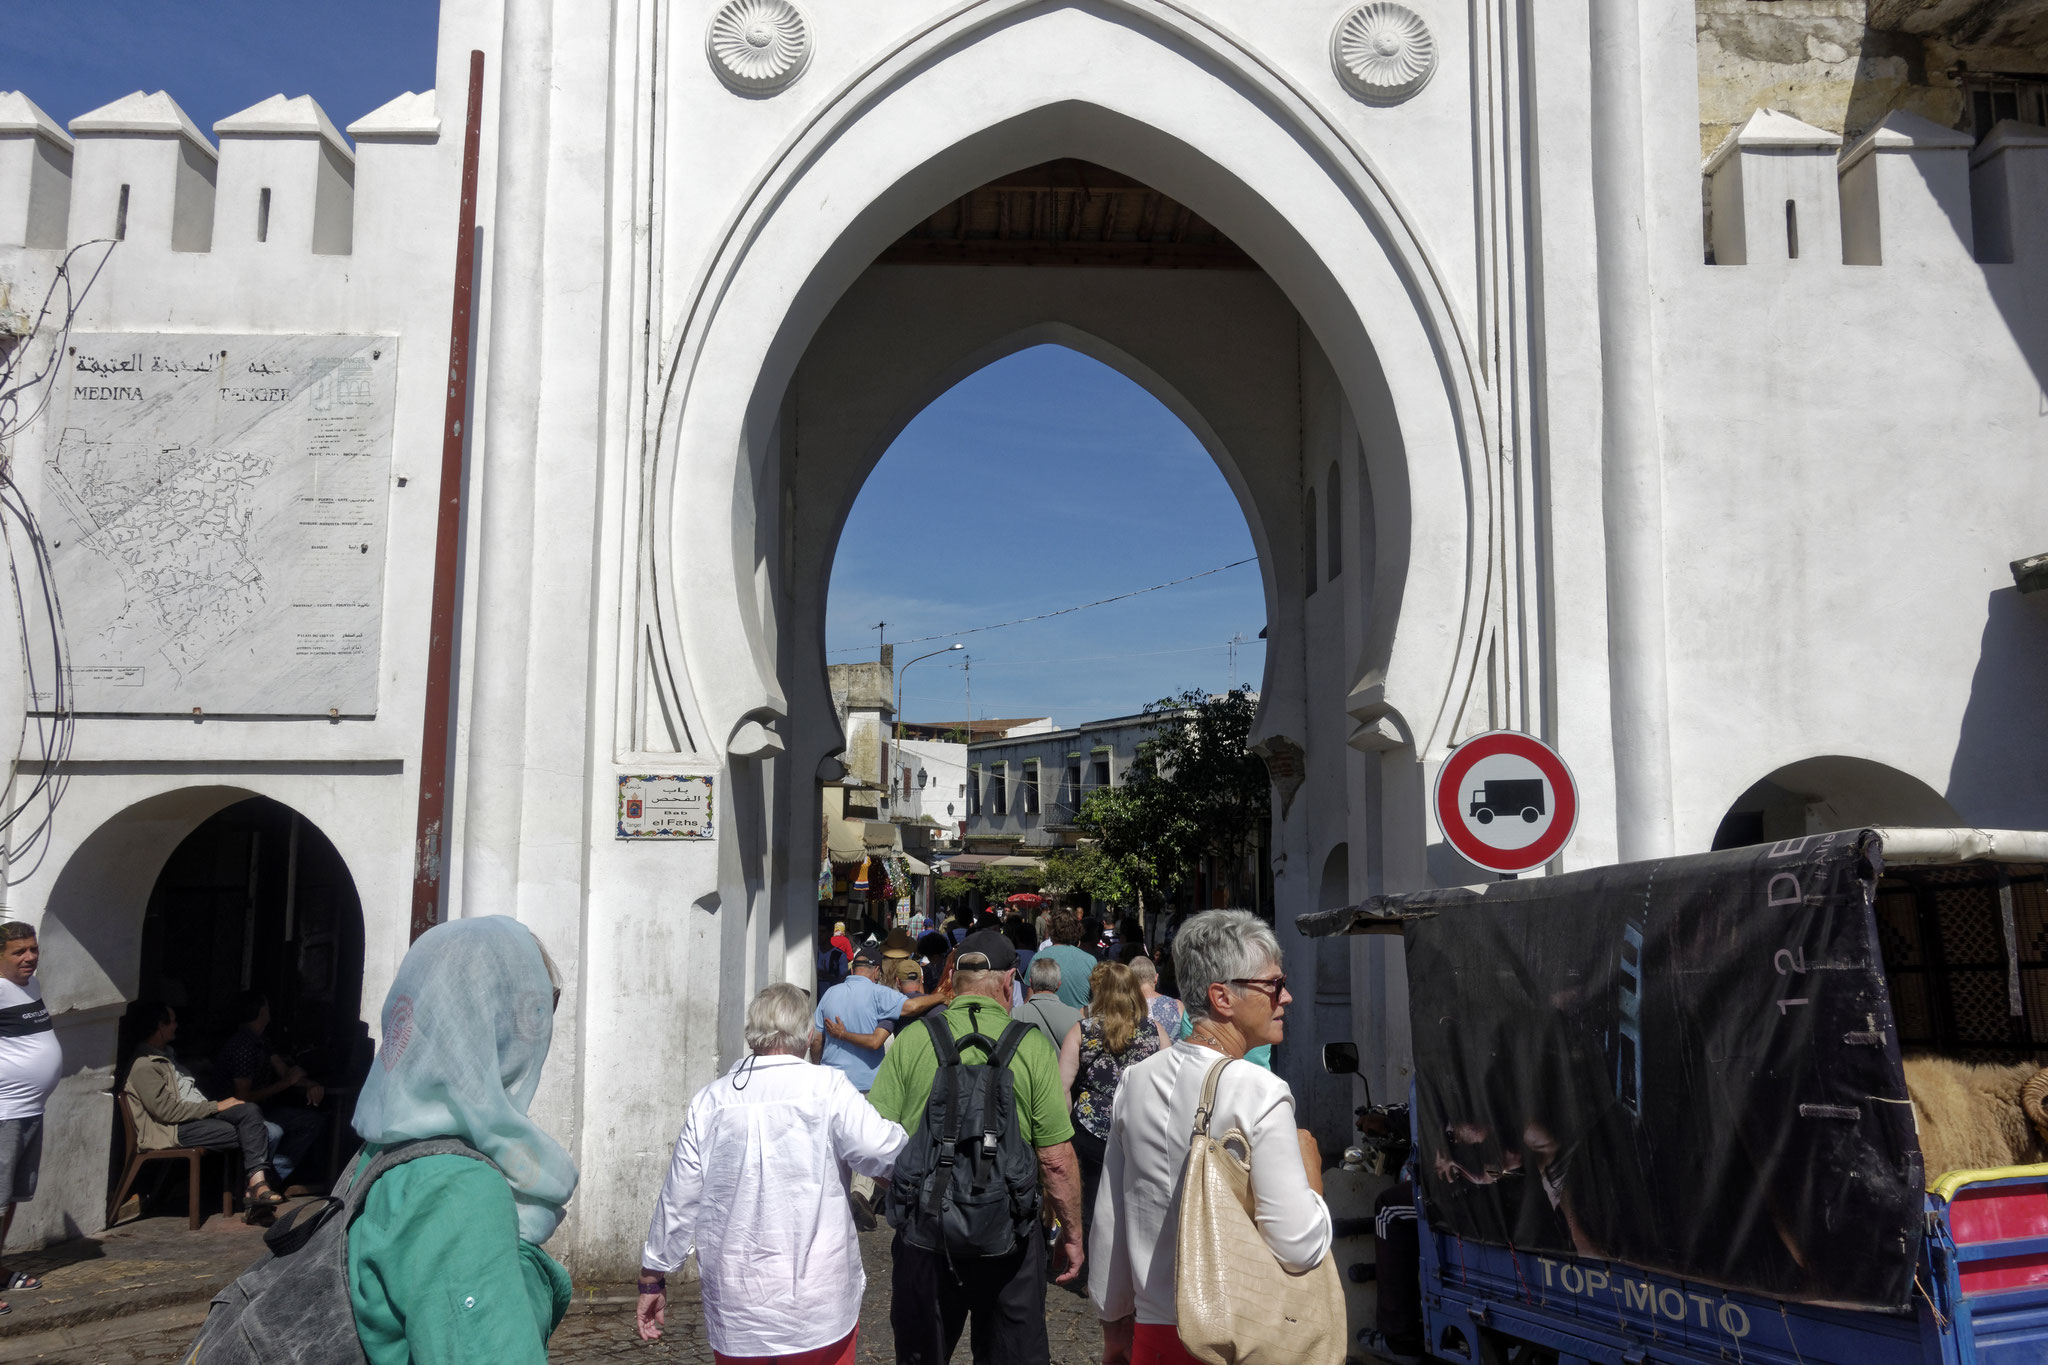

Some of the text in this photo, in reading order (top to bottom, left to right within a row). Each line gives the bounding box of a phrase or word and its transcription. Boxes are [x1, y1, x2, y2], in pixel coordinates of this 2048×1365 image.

[76, 353, 144, 378] العتيقة
[73, 386, 144, 401] MEDINA
[1774, 946, 1809, 1015] 12
[1538, 1257, 1751, 1338] TOP-MOTO
